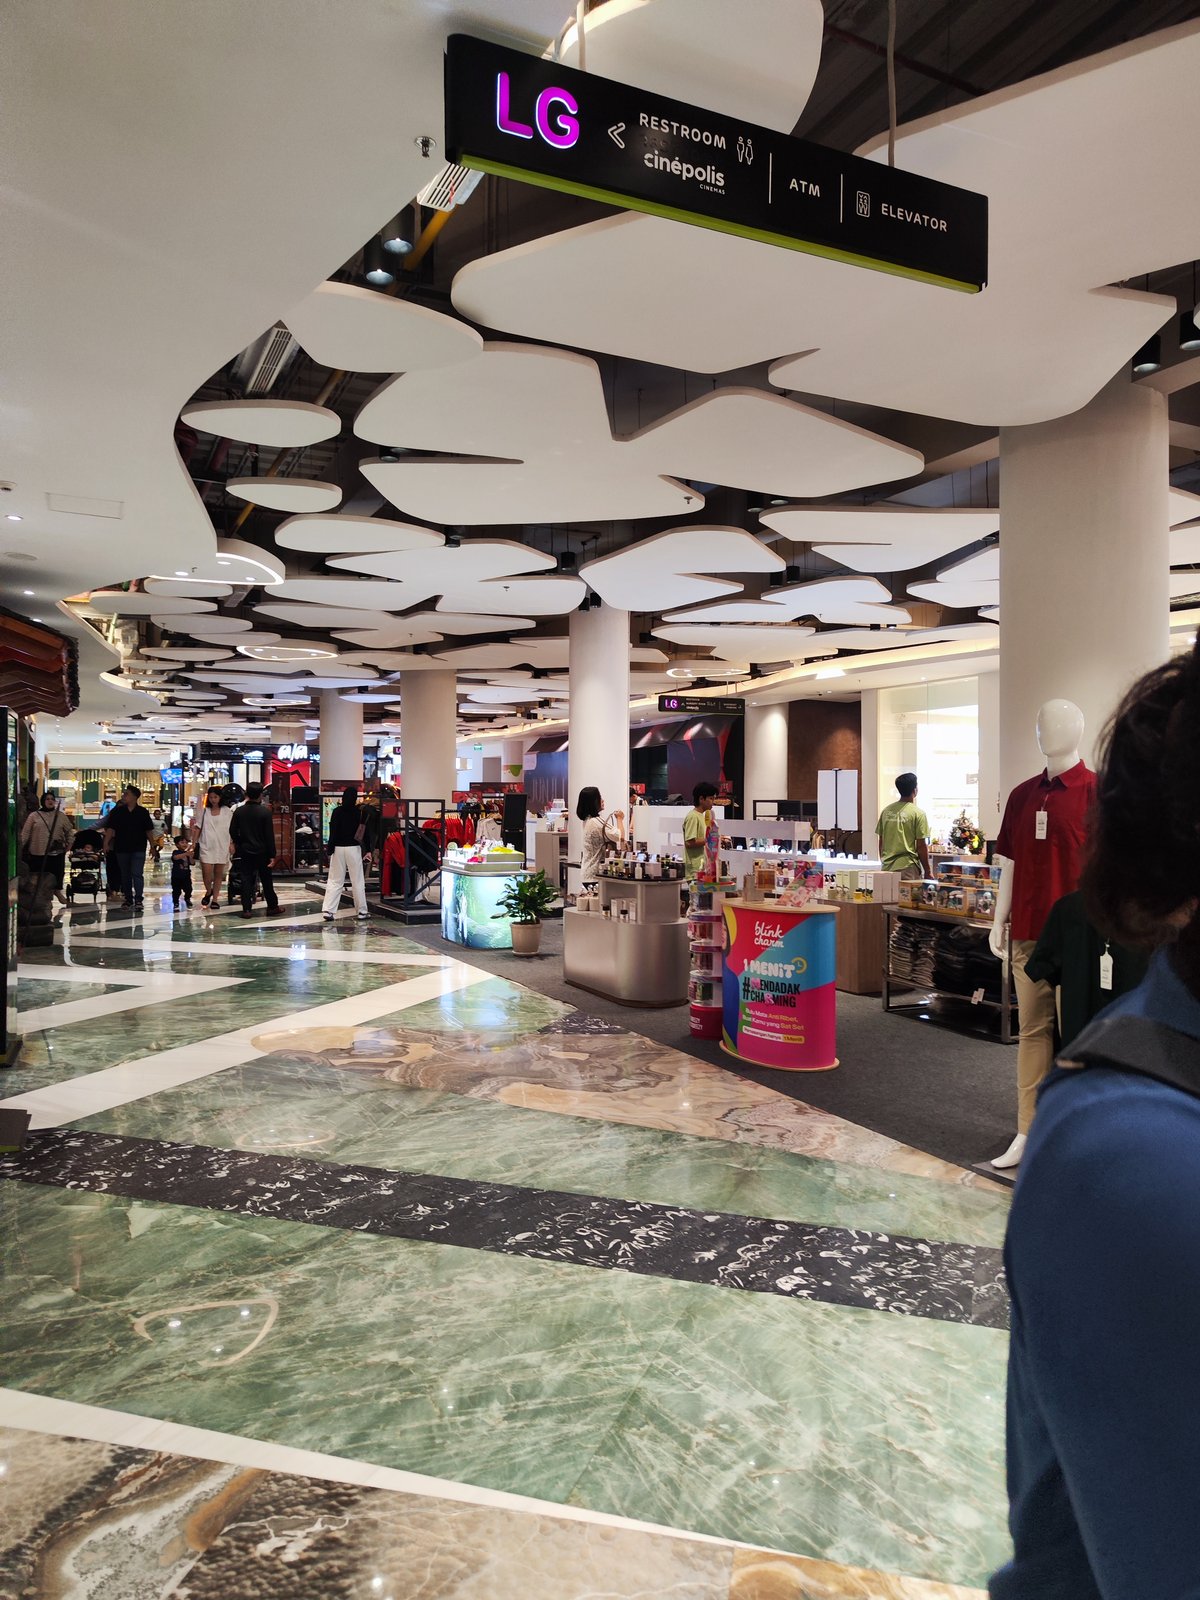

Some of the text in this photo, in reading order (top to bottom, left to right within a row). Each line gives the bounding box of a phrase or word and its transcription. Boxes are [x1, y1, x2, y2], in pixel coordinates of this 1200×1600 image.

[496, 71, 579, 149] LG
[639, 112, 726, 150] RESTROOM
[643, 150, 725, 187] cinépolis
[699, 184, 726, 195] CINEMAS
[789, 178, 821, 198] ATM
[881, 203, 948, 232] ELEVATOR
[664, 699, 678, 709] LG
[754, 921, 784, 939] blink
[754, 935, 784, 948] charm
[743, 958, 748, 972] 1
[742, 976, 801, 995] #MENDADAK
[742, 987, 797, 1008] #CHARMING
